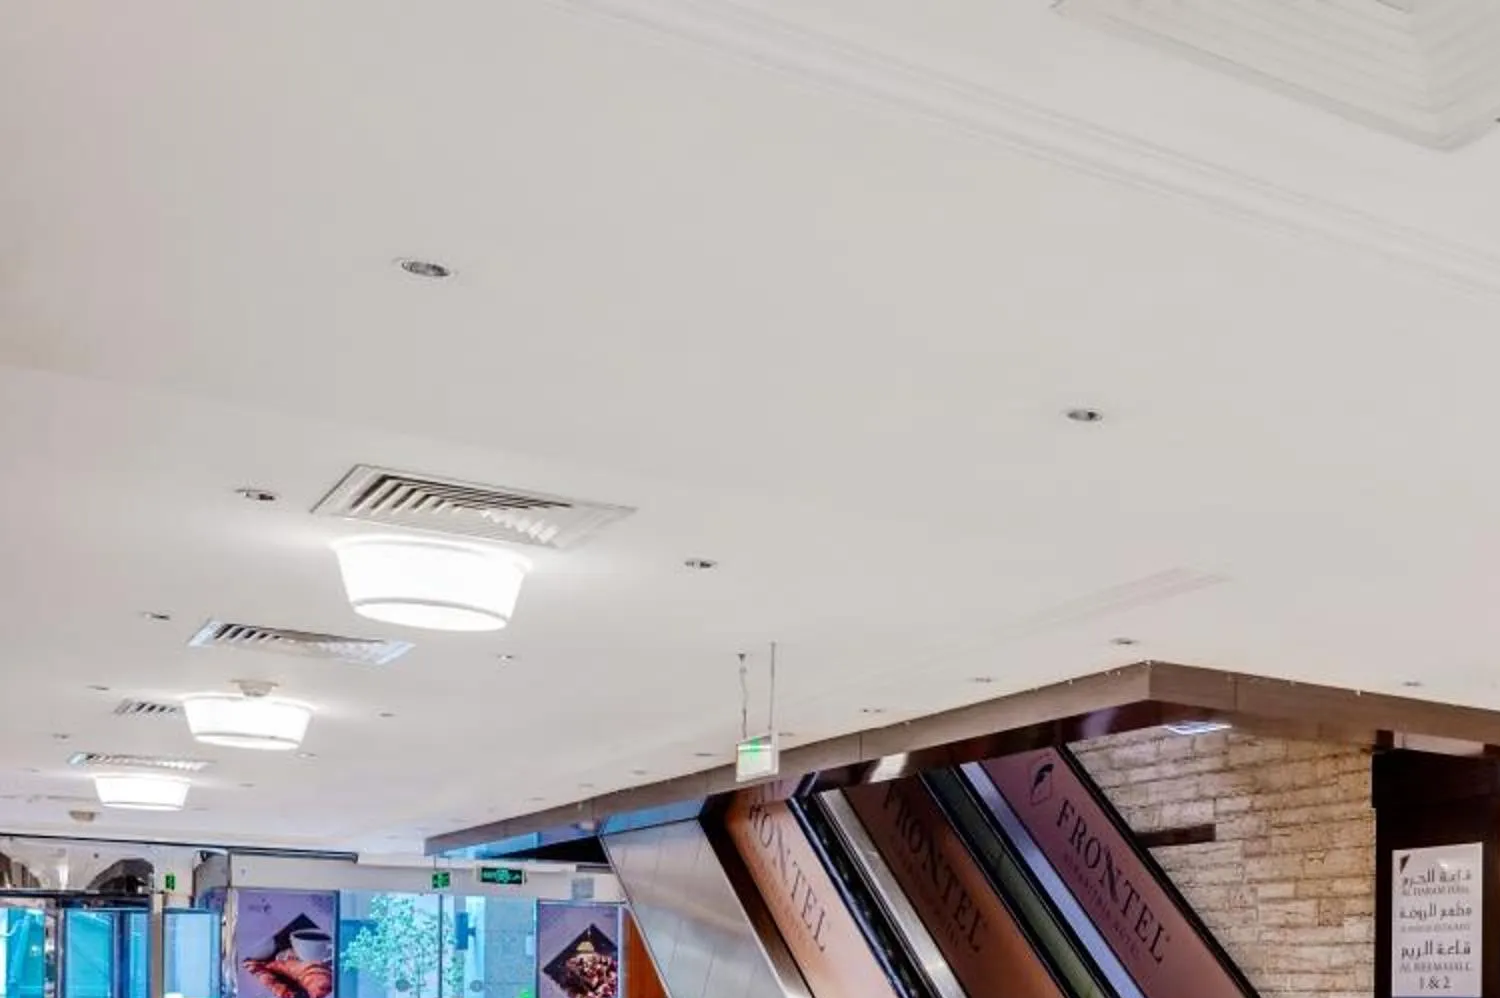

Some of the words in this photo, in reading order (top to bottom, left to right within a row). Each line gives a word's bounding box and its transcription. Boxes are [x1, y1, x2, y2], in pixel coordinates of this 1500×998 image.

[1056, 799, 1170, 964] FRONTEL
[1436, 939, 1472, 956] قاعة
[1442, 975, 1452, 990] 2
